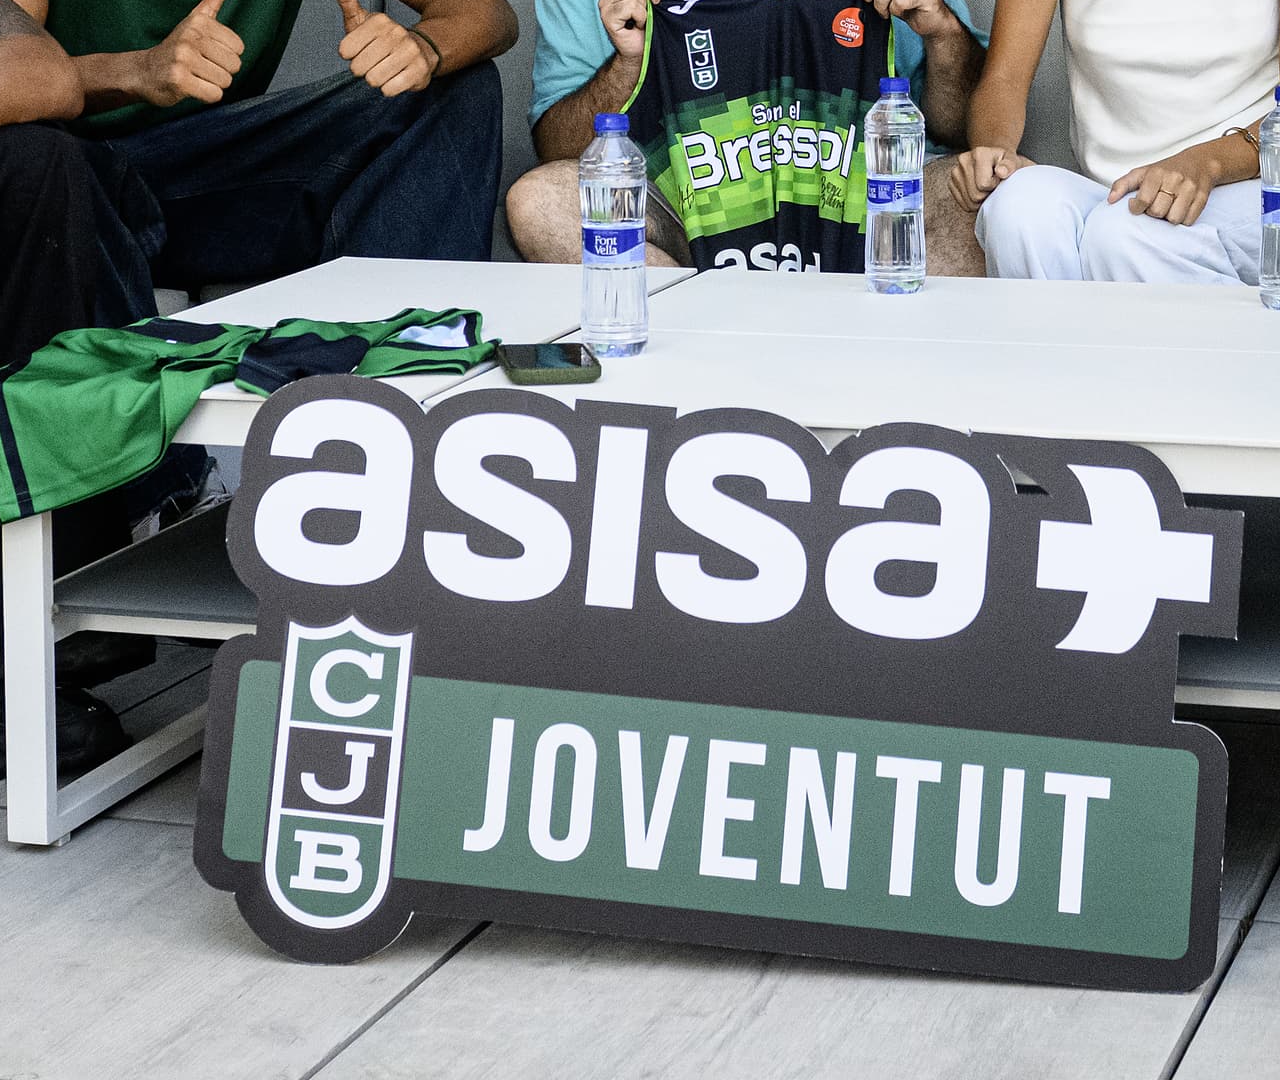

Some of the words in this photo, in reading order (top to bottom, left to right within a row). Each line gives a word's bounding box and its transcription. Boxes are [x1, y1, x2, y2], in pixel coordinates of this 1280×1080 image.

[691, 34, 713, 84] CJB
[788, 100, 801, 121] el
[681, 124, 856, 190] Bressol
[594, 235, 618, 246] Font
[594, 244, 618, 256] Vella
[463, 717, 1112, 915] JOVENTUT
